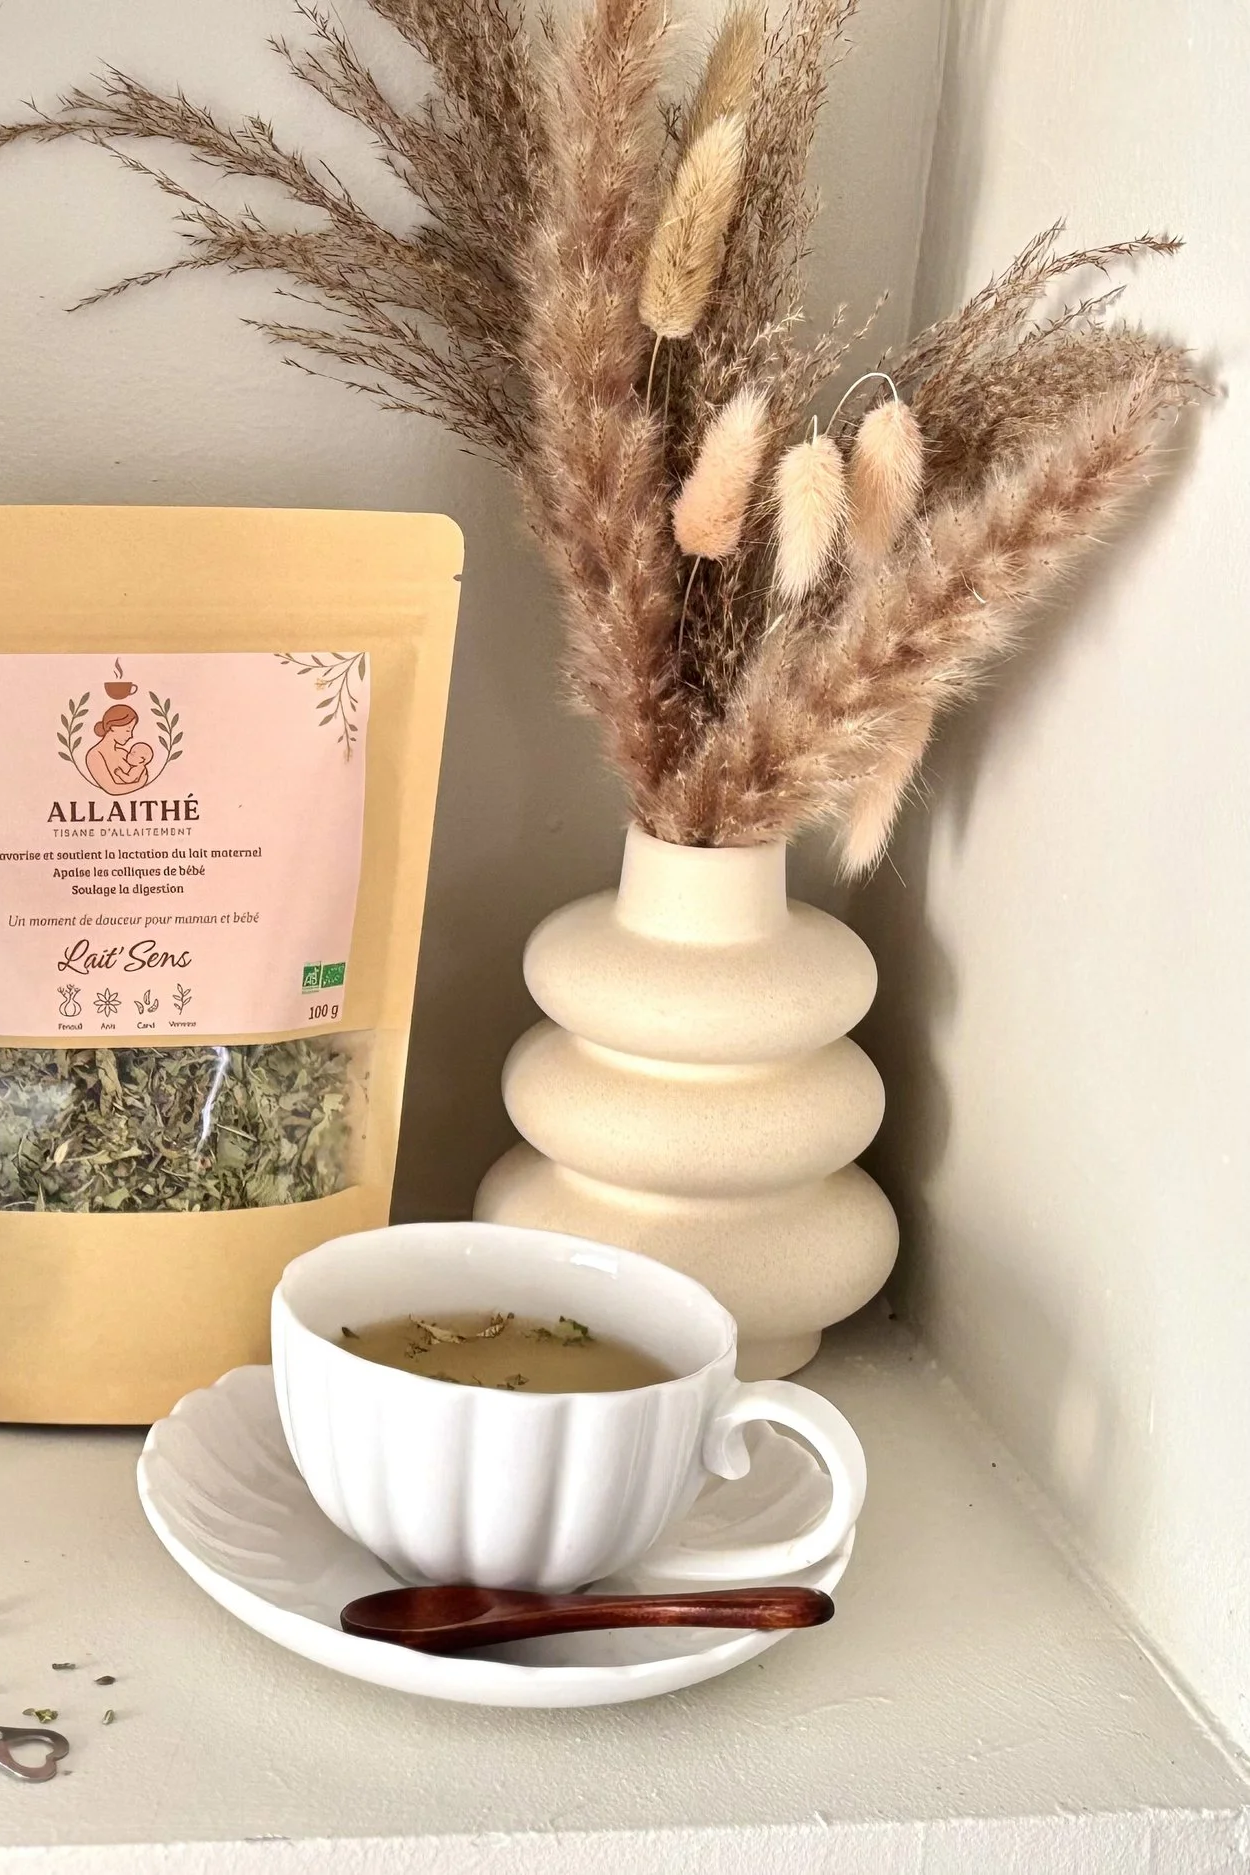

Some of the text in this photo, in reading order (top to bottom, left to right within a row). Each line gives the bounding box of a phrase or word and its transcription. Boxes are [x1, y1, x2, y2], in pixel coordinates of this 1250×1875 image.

[47, 793, 200, 822] ALLAITHÉ
[53, 827, 192, 838] TISANE D'ALLAITEMENT
[43, 852, 54, 860] et
[56, 849, 102, 860] soutient
[105, 849, 116, 860] la
[118, 849, 169, 860] lactation
[171, 848, 186, 859] du
[189, 847, 208, 858] lait
[211, 847, 262, 858] maternel
[53, 865, 206, 879] Apaise les colliques de bébé
[71, 883, 184, 897] Soulage la digestion
[8, 911, 260, 928] Un moment de douceur pour maman et bébé
[57, 939, 192, 975] Lait' Sens
[308, 1003, 339, 1020] 100 g
